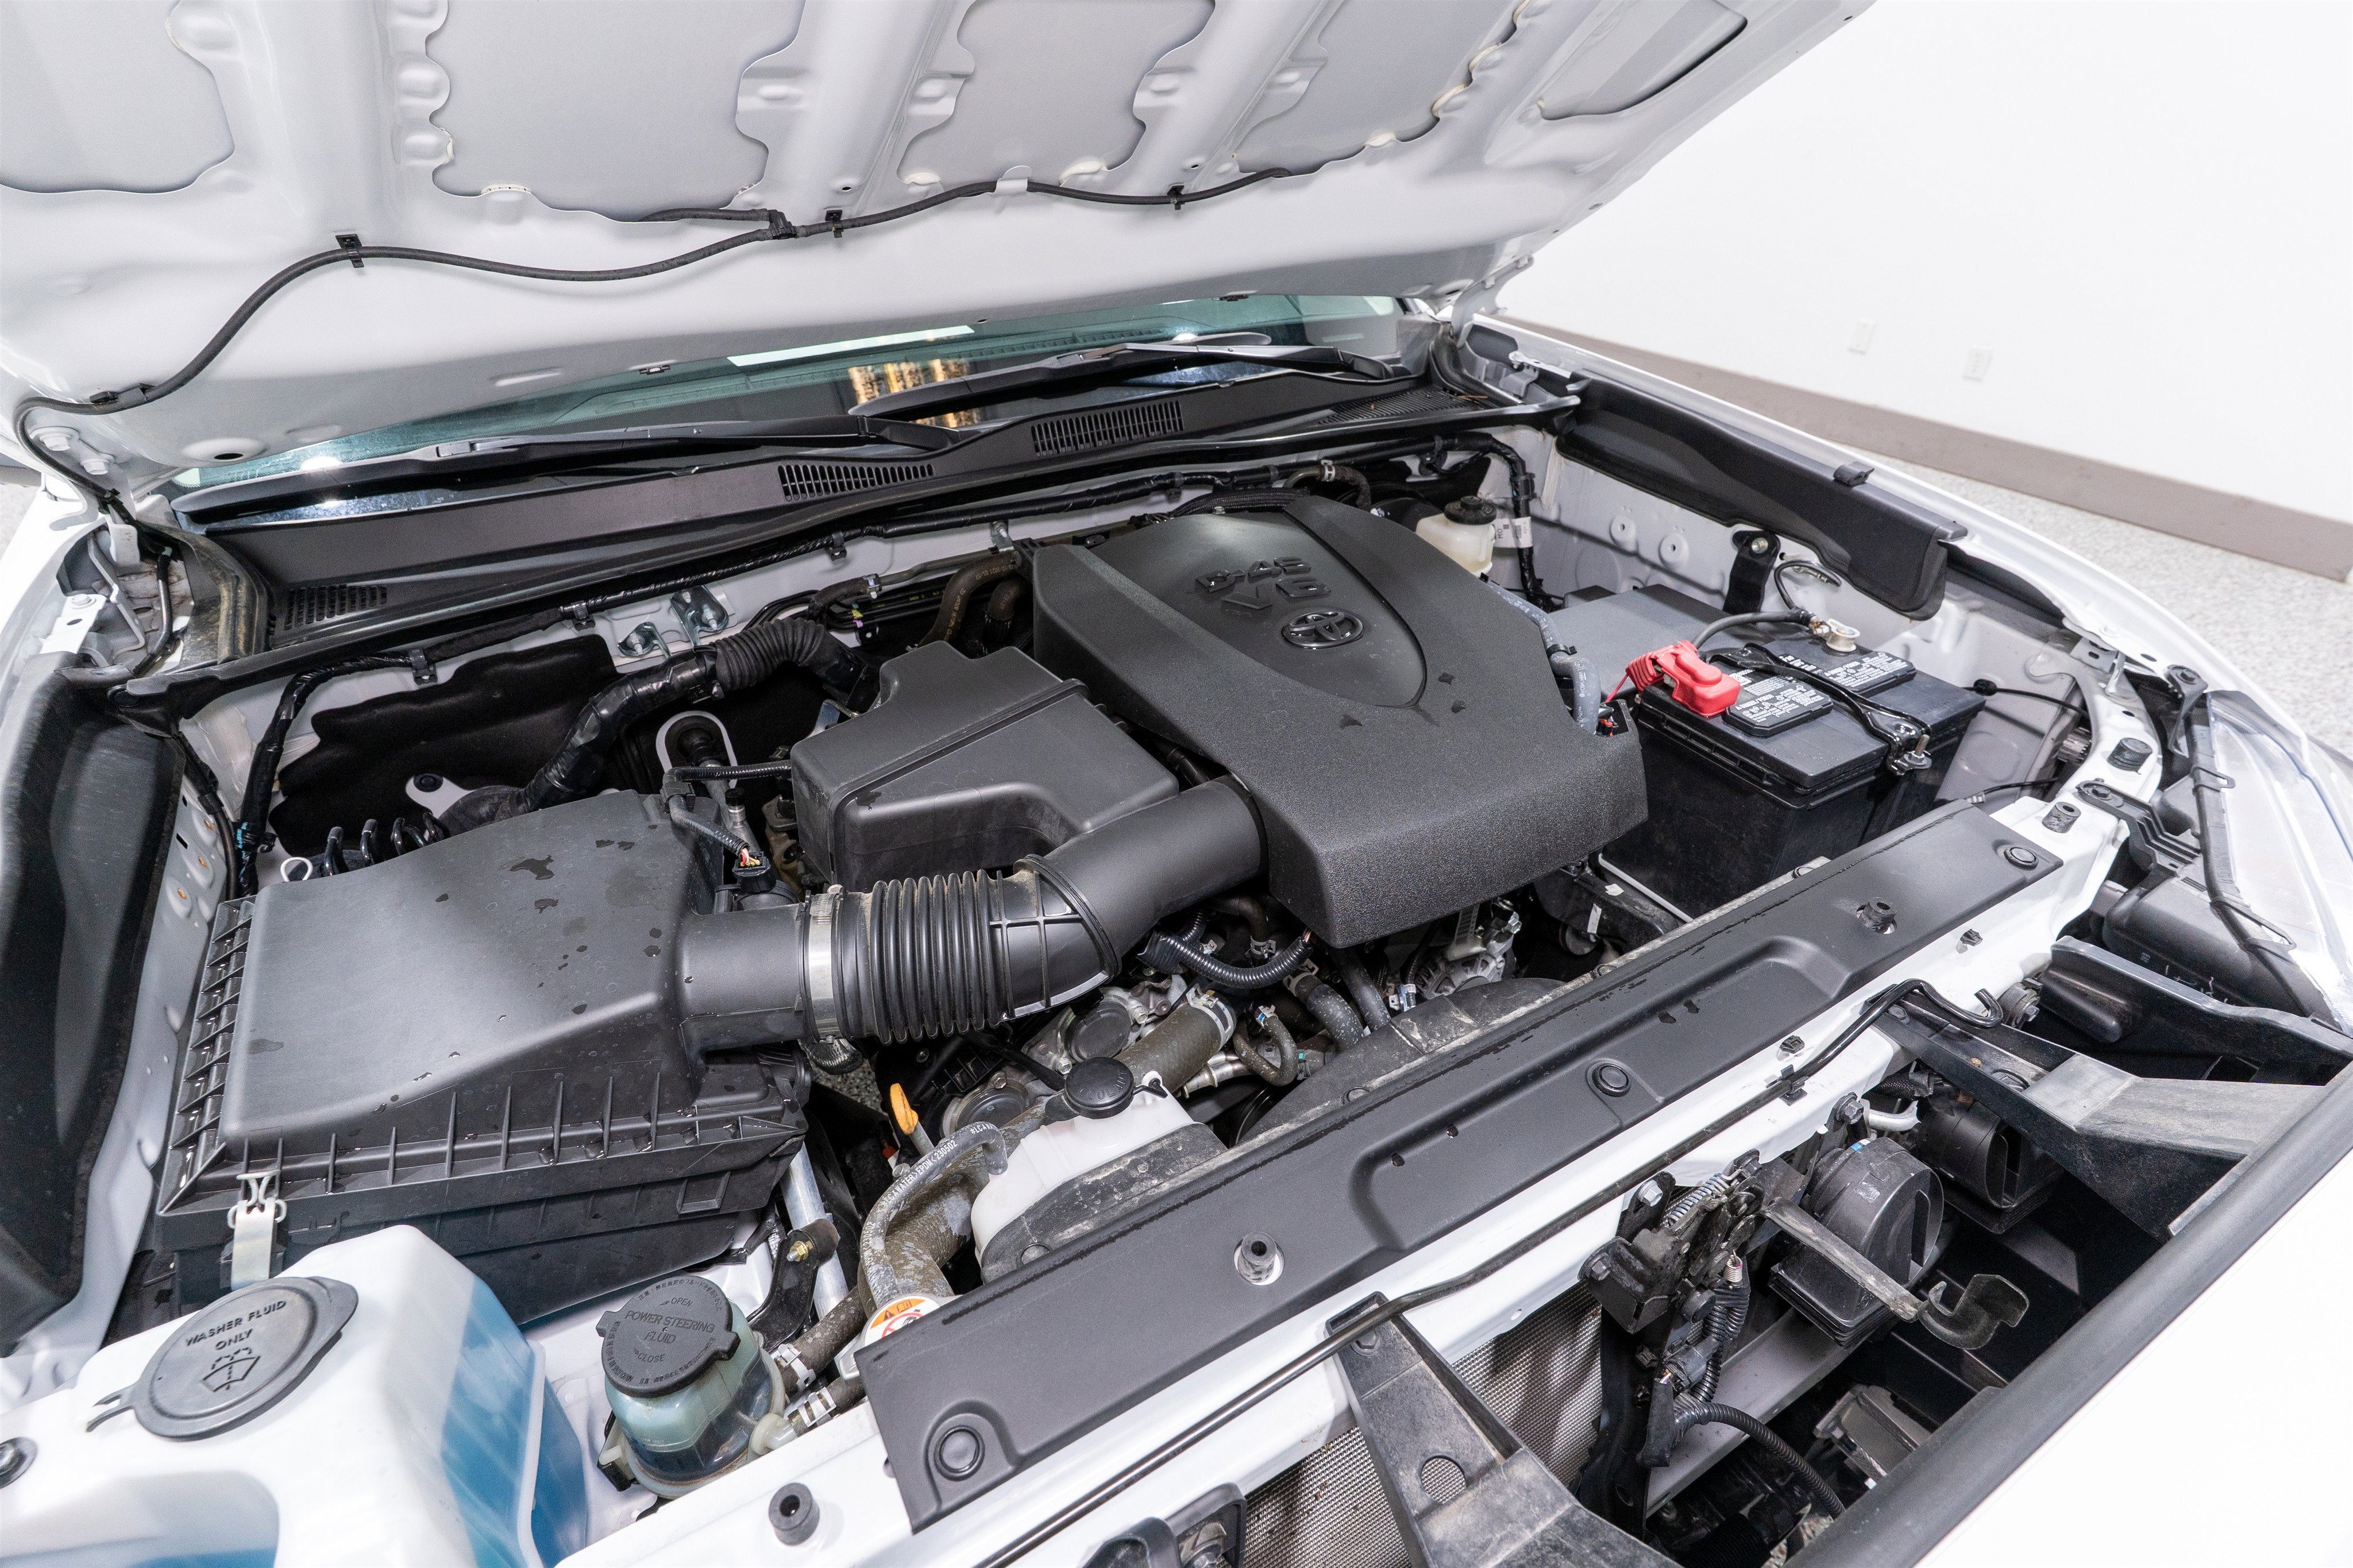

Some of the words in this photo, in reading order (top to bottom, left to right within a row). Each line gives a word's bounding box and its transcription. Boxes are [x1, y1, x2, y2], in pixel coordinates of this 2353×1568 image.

[1220, 576, 1332, 610] V6
[1079, 1072, 1128, 1100] COOLANT
[671, 1297, 693, 1308] OPEN
[186, 1318, 243, 1346] WASHER
[248, 1300, 287, 1321] FLUID
[625, 1310, 663, 1325] POWER
[664, 1316, 715, 1334] STEERING
[215, 1328, 253, 1350] ONLY
[644, 1331, 677, 1344] FLUID
[637, 1352, 666, 1363] CLOSE
